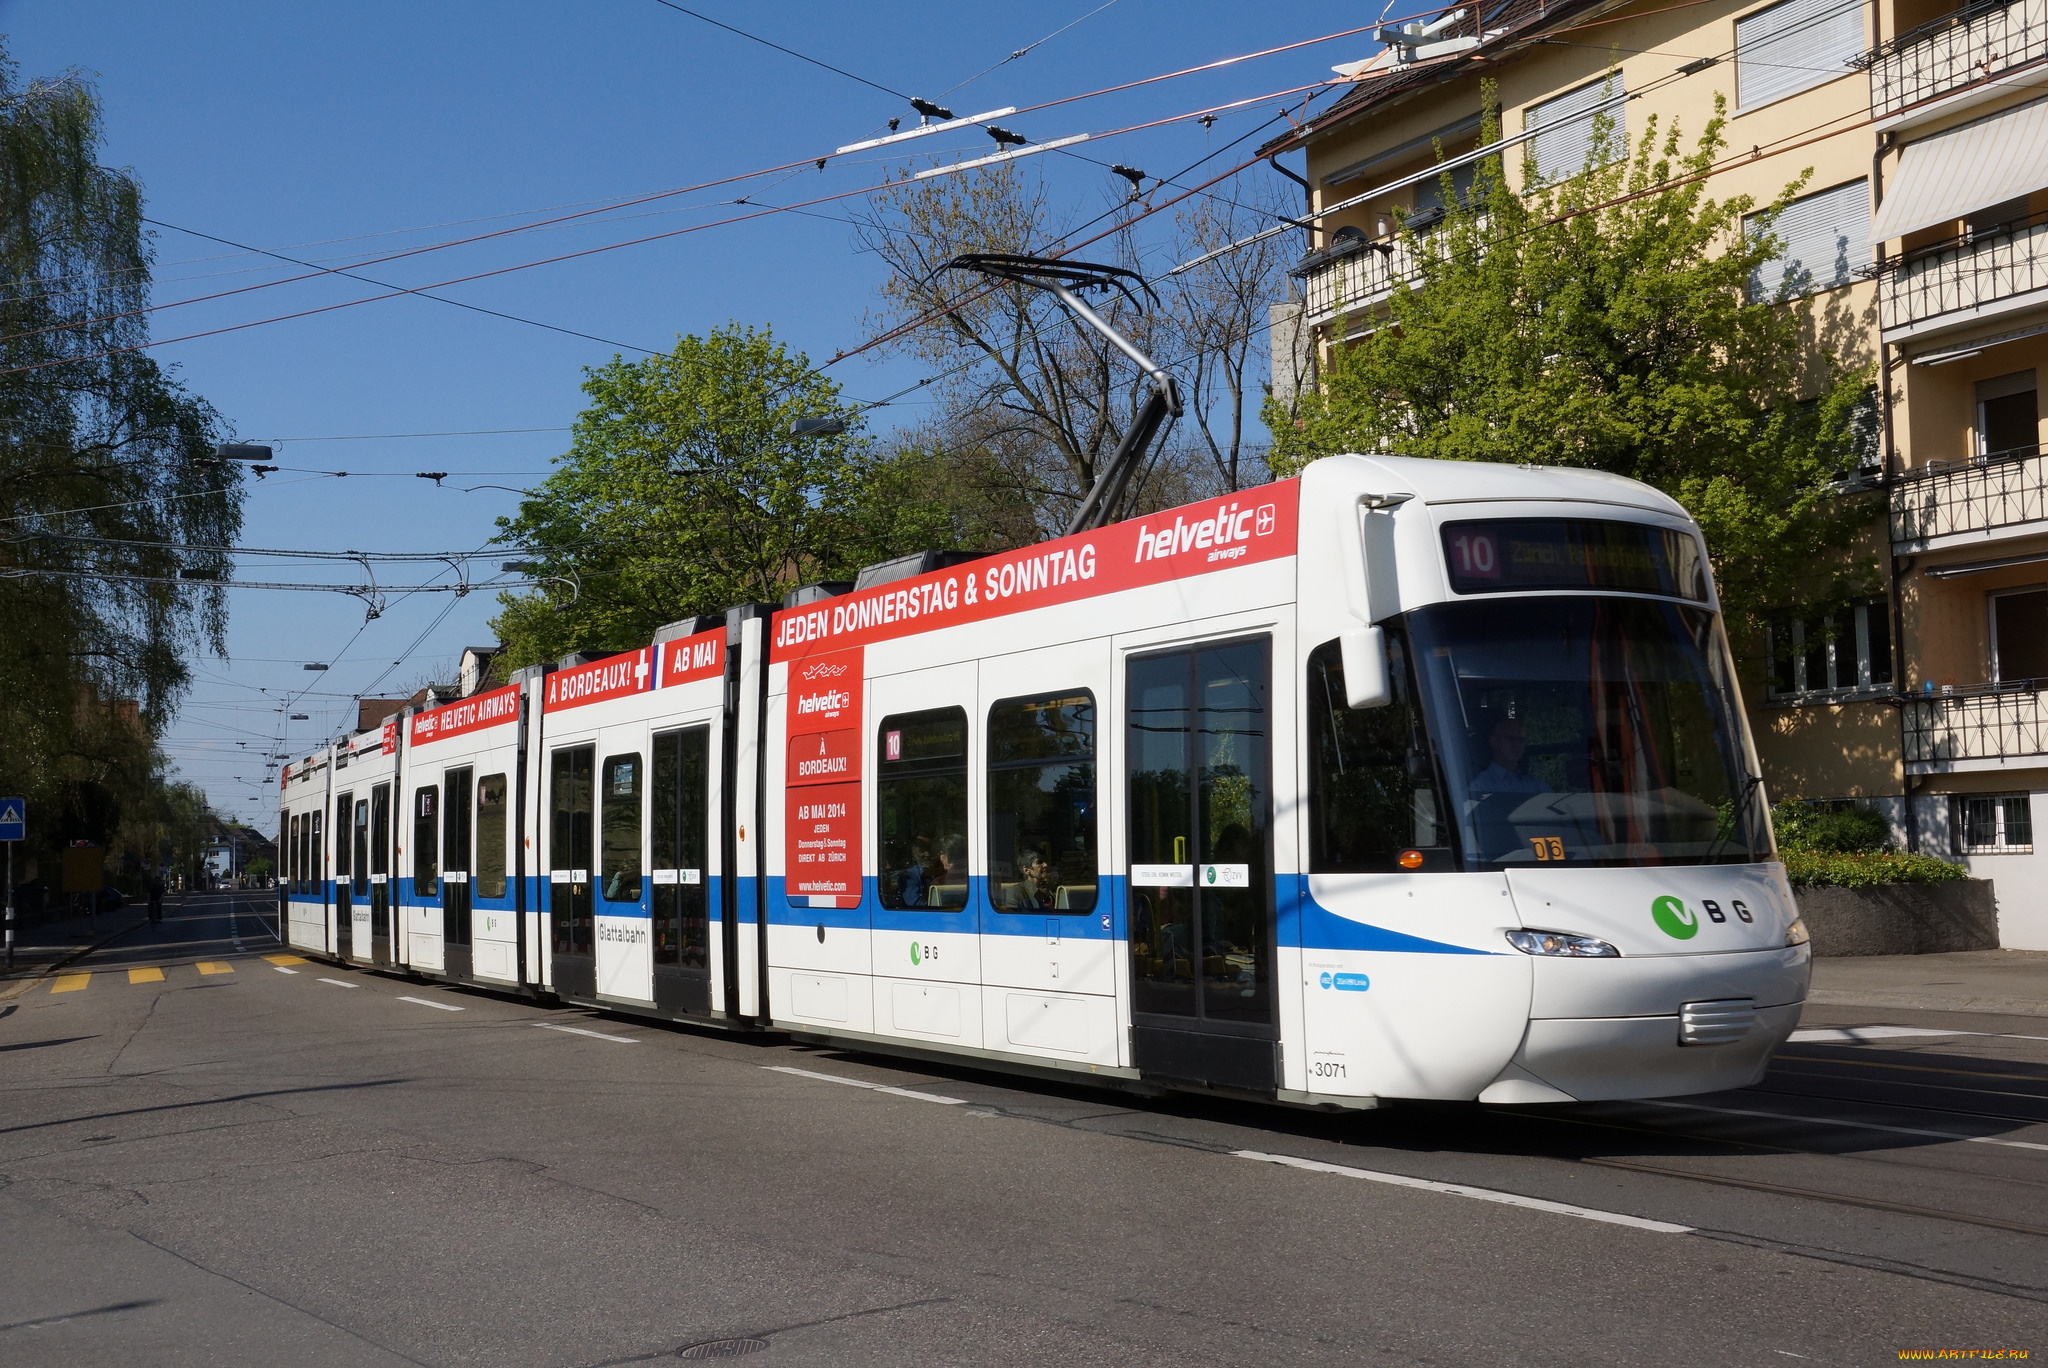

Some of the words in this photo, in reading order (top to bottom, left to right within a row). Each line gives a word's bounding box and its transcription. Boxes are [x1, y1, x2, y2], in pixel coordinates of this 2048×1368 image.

[1135, 502, 1254, 564] helvetic
[1206, 544, 1247, 563] airways
[1455, 535, 1494, 572] 10
[776, 609, 828, 649] JEDEN
[832, 576, 959, 633] DONNERSTAG
[964, 574, 978, 605] &
[984, 543, 1096, 601] SONNTAG
[548, 675, 557, 704] À
[561, 661, 632, 701] BORDEAUX!
[673, 648, 690, 674] AB
[693, 639, 717, 669] MAI
[440, 704, 476, 732] HELVETIC
[478, 692, 516, 723] AIRWAYS
[798, 689, 842, 715] helvetic
[819, 737, 826, 755] À
[888, 734, 900, 756] 10
[799, 756, 847, 776] BORDEAUX!
[798, 805, 810, 820] AB
[811, 804, 826, 819] MAI
[827, 803, 846, 818] 2014
[813, 823, 830, 834] JEDEN
[798, 839, 824, 850] Donnerstag
[827, 838, 846, 850] Sonntag
[798, 853, 815, 863] DIREKT
[818, 853, 825, 863] AB
[828, 850, 846, 863] ZÜRICH
[798, 880, 847, 892] www.helvetic.com
[599, 922, 646, 945] Glattalbahn
[1315, 1062, 1347, 1078] 3071
